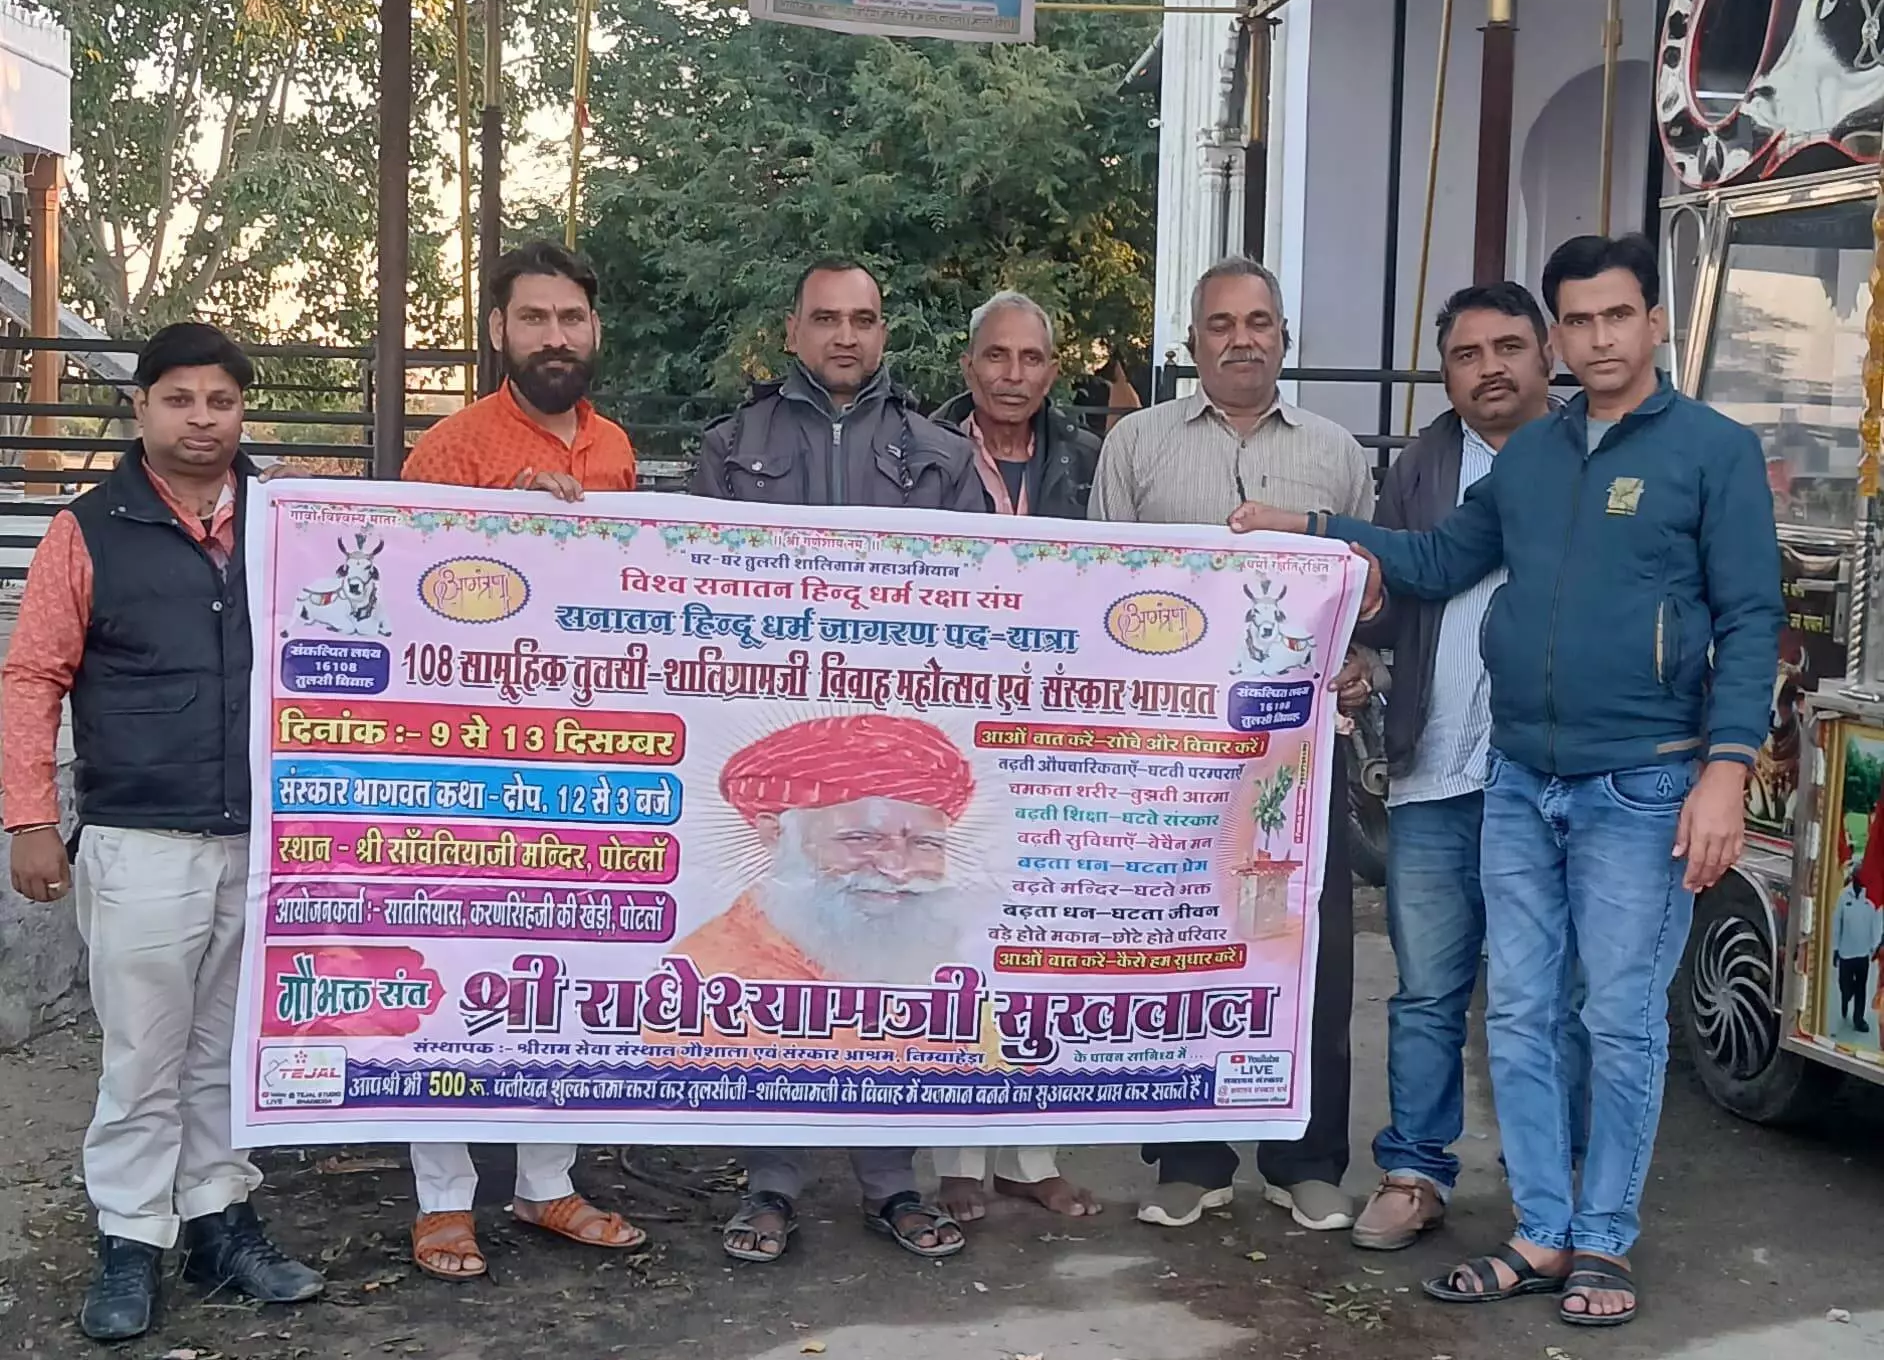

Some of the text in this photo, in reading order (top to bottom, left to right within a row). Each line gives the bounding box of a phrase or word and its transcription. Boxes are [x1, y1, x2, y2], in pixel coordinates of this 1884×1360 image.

[745, 553, 789, 572] तुलसी
[620, 567, 1024, 610] विश्व सनातन हिन्दू धर्म रक्षा संघ
[555, 602, 1079, 654] सनातन हिन्दू धर्म जागरण पद-यात्रा
[315, 661, 357, 672] 16108
[296, 674, 333, 688] तुलसी
[403, 642, 454, 685] 108
[458, 638, 569, 704] सामूहिक
[817, 651, 893, 710] विवाह
[895, 655, 993, 712] महोत्सव
[997, 660, 1032, 714] एवं
[1041, 661, 1126, 714] संस्कार
[1129, 679, 1218, 719] भागवत
[279, 706, 675, 755] दिनांक 9 से 13 दिसम्बर
[1184, 735, 1232, 753] विचार
[278, 765, 671, 816] संस्कार भागवत कथा दोप. 12 से 3 बजे
[1008, 782, 1231, 804] चमकता आत्मा
[1163, 810, 1219, 827] संस्कार
[278, 837, 332, 862] स्थान
[356, 827, 384, 863] श्री
[1190, 836, 1213, 849] मन
[274, 886, 366, 925] आयोजनकर्ता
[556, 892, 579, 929] की
[1168, 903, 1220, 920] जीवन
[1016, 925, 1227, 945] होते होते परिवार
[1150, 955, 1171, 968] हम
[1172, 952, 1212, 973] सुधार
[277, 953, 432, 1025] गौभक्त संत
[460, 953, 1280, 1065] श्री राधेश्यामजी सुखवाल
[413, 1039, 839, 1060] संस्थापक श्रीराम सेवा संस्थान गौशाला एवं संस्कार
[1074, 1049, 1087, 1063] के
[279, 1067, 341, 1080] TEJAL
[1240, 1064, 1274, 1075] LIVE
[349, 1070, 401, 1097] आपश्री
[403, 1071, 422, 1097] भी
[428, 1070, 466, 1097] 500
[551, 1077, 589, 1105] शुल्क
[593, 1078, 625, 1100] जमा
[626, 1078, 658, 1100] करा
[660, 1079, 685, 1101] कर
[841, 1077, 858, 1103] के
[861, 1077, 904, 1104] विवाह
[906, 1078, 920, 1103] में
[920, 1083, 973, 1104] यजमान
[1012, 1083, 1032, 1103] का
[1035, 1082, 1095, 1109] सुअवसर
[1097, 1084, 1123, 1103] प्राप्त
[1125, 1081, 1149, 1101] कर
[1151, 1076, 1188, 1101] सकते
[1189, 1074, 1202, 1101] हैं
